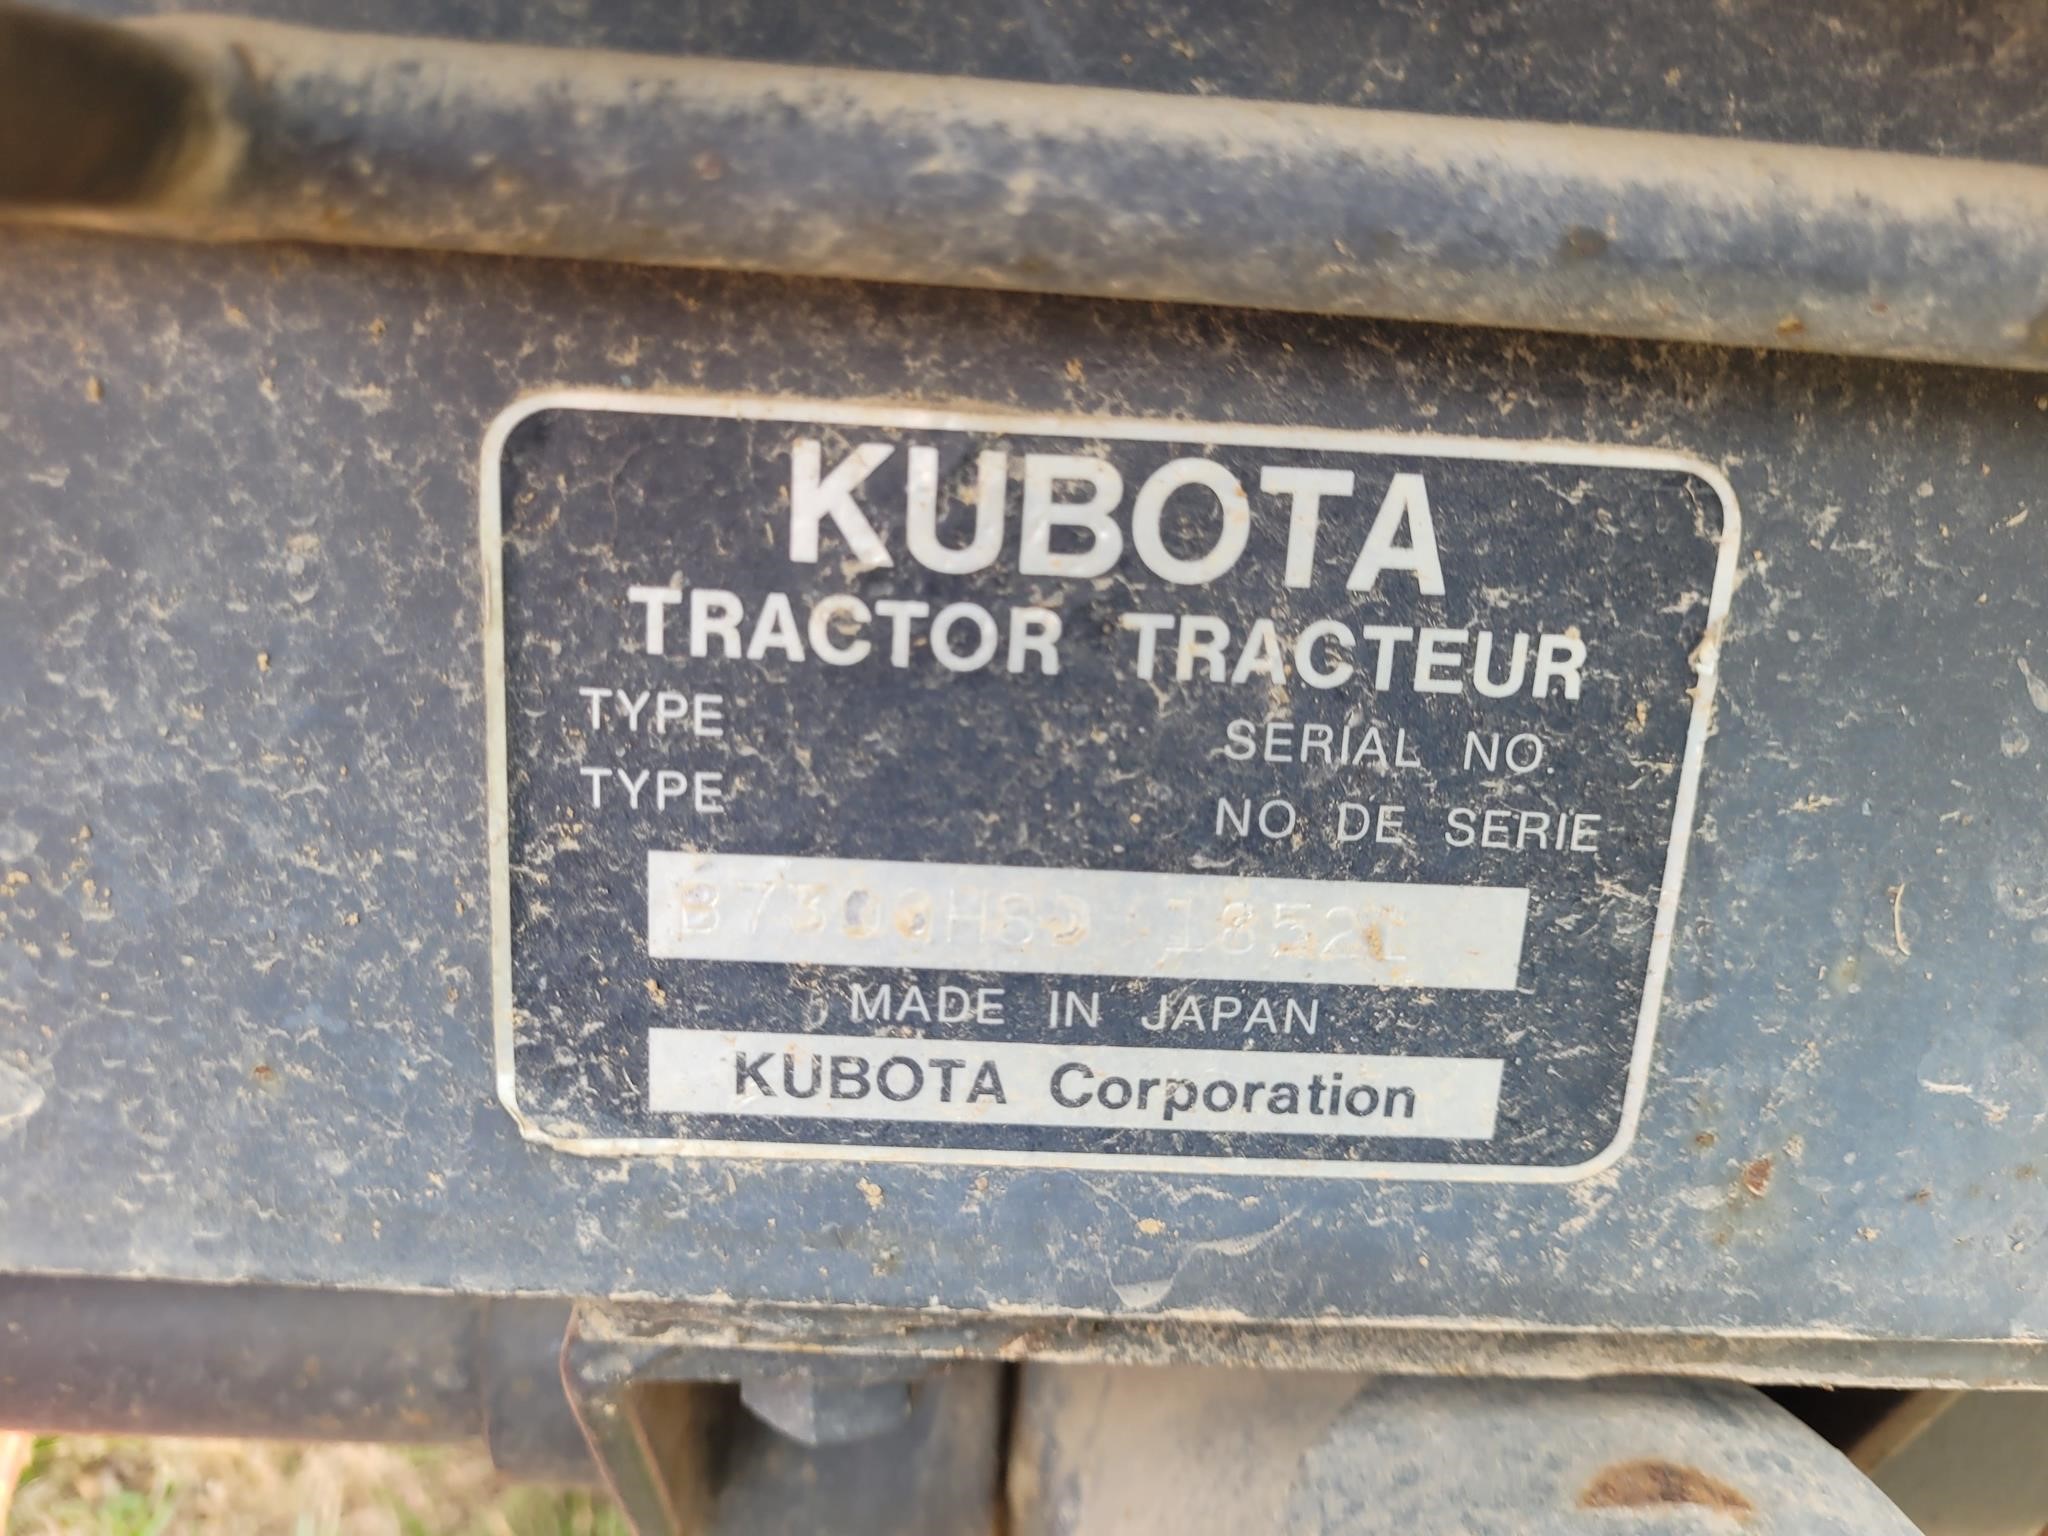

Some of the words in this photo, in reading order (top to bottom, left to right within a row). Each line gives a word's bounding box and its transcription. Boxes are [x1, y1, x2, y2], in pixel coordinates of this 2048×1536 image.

[789, 439, 1446, 596] KUBOTA
[628, 586, 1062, 676] TRACTOR
[1121, 611, 1588, 700] TRACTEUR
[579, 687, 724, 737] TYPE
[1223, 720, 1421, 769] SERIAL
[1463, 730, 1555, 775] NO.
[579, 766, 725, 814] TYPE
[1214, 798, 1297, 841] NO
[1337, 801, 1406, 845] DE
[1444, 806, 1602, 853] SERIE
[850, 983, 1006, 1026] MADE
[1048, 989, 1100, 1029] IN
[1140, 994, 1320, 1035] JAPAN
[735, 1051, 1007, 1105] KUBOTA
[1049, 1061, 1417, 1121] Corporation
